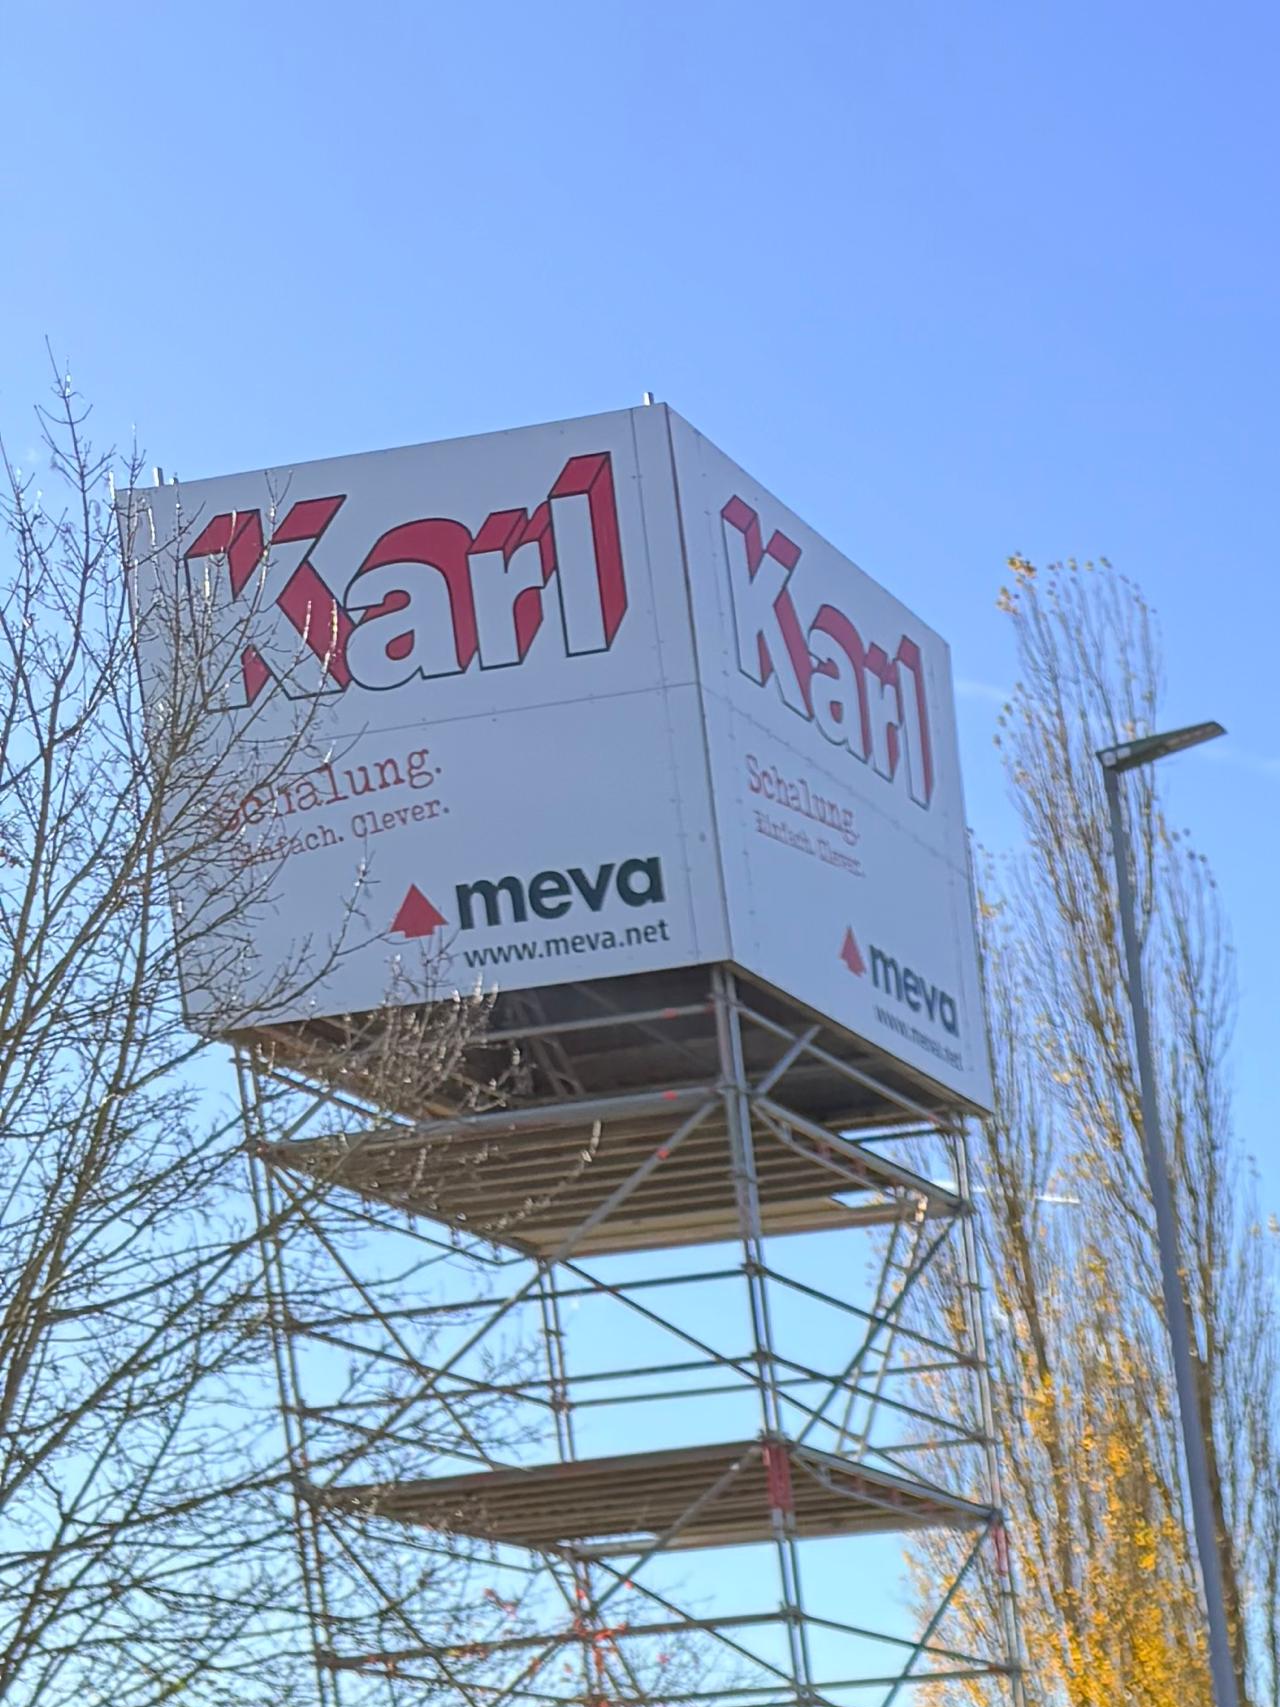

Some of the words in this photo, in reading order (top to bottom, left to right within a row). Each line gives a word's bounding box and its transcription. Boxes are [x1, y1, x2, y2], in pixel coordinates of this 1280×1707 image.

[185, 451, 628, 713] Karl
[720, 494, 934, 811] Karl
[351, 799, 450, 839] Clever.
[455, 856, 667, 931] meva
[463, 919, 671, 959] www.meva.net
[869, 943, 960, 1039] meva
